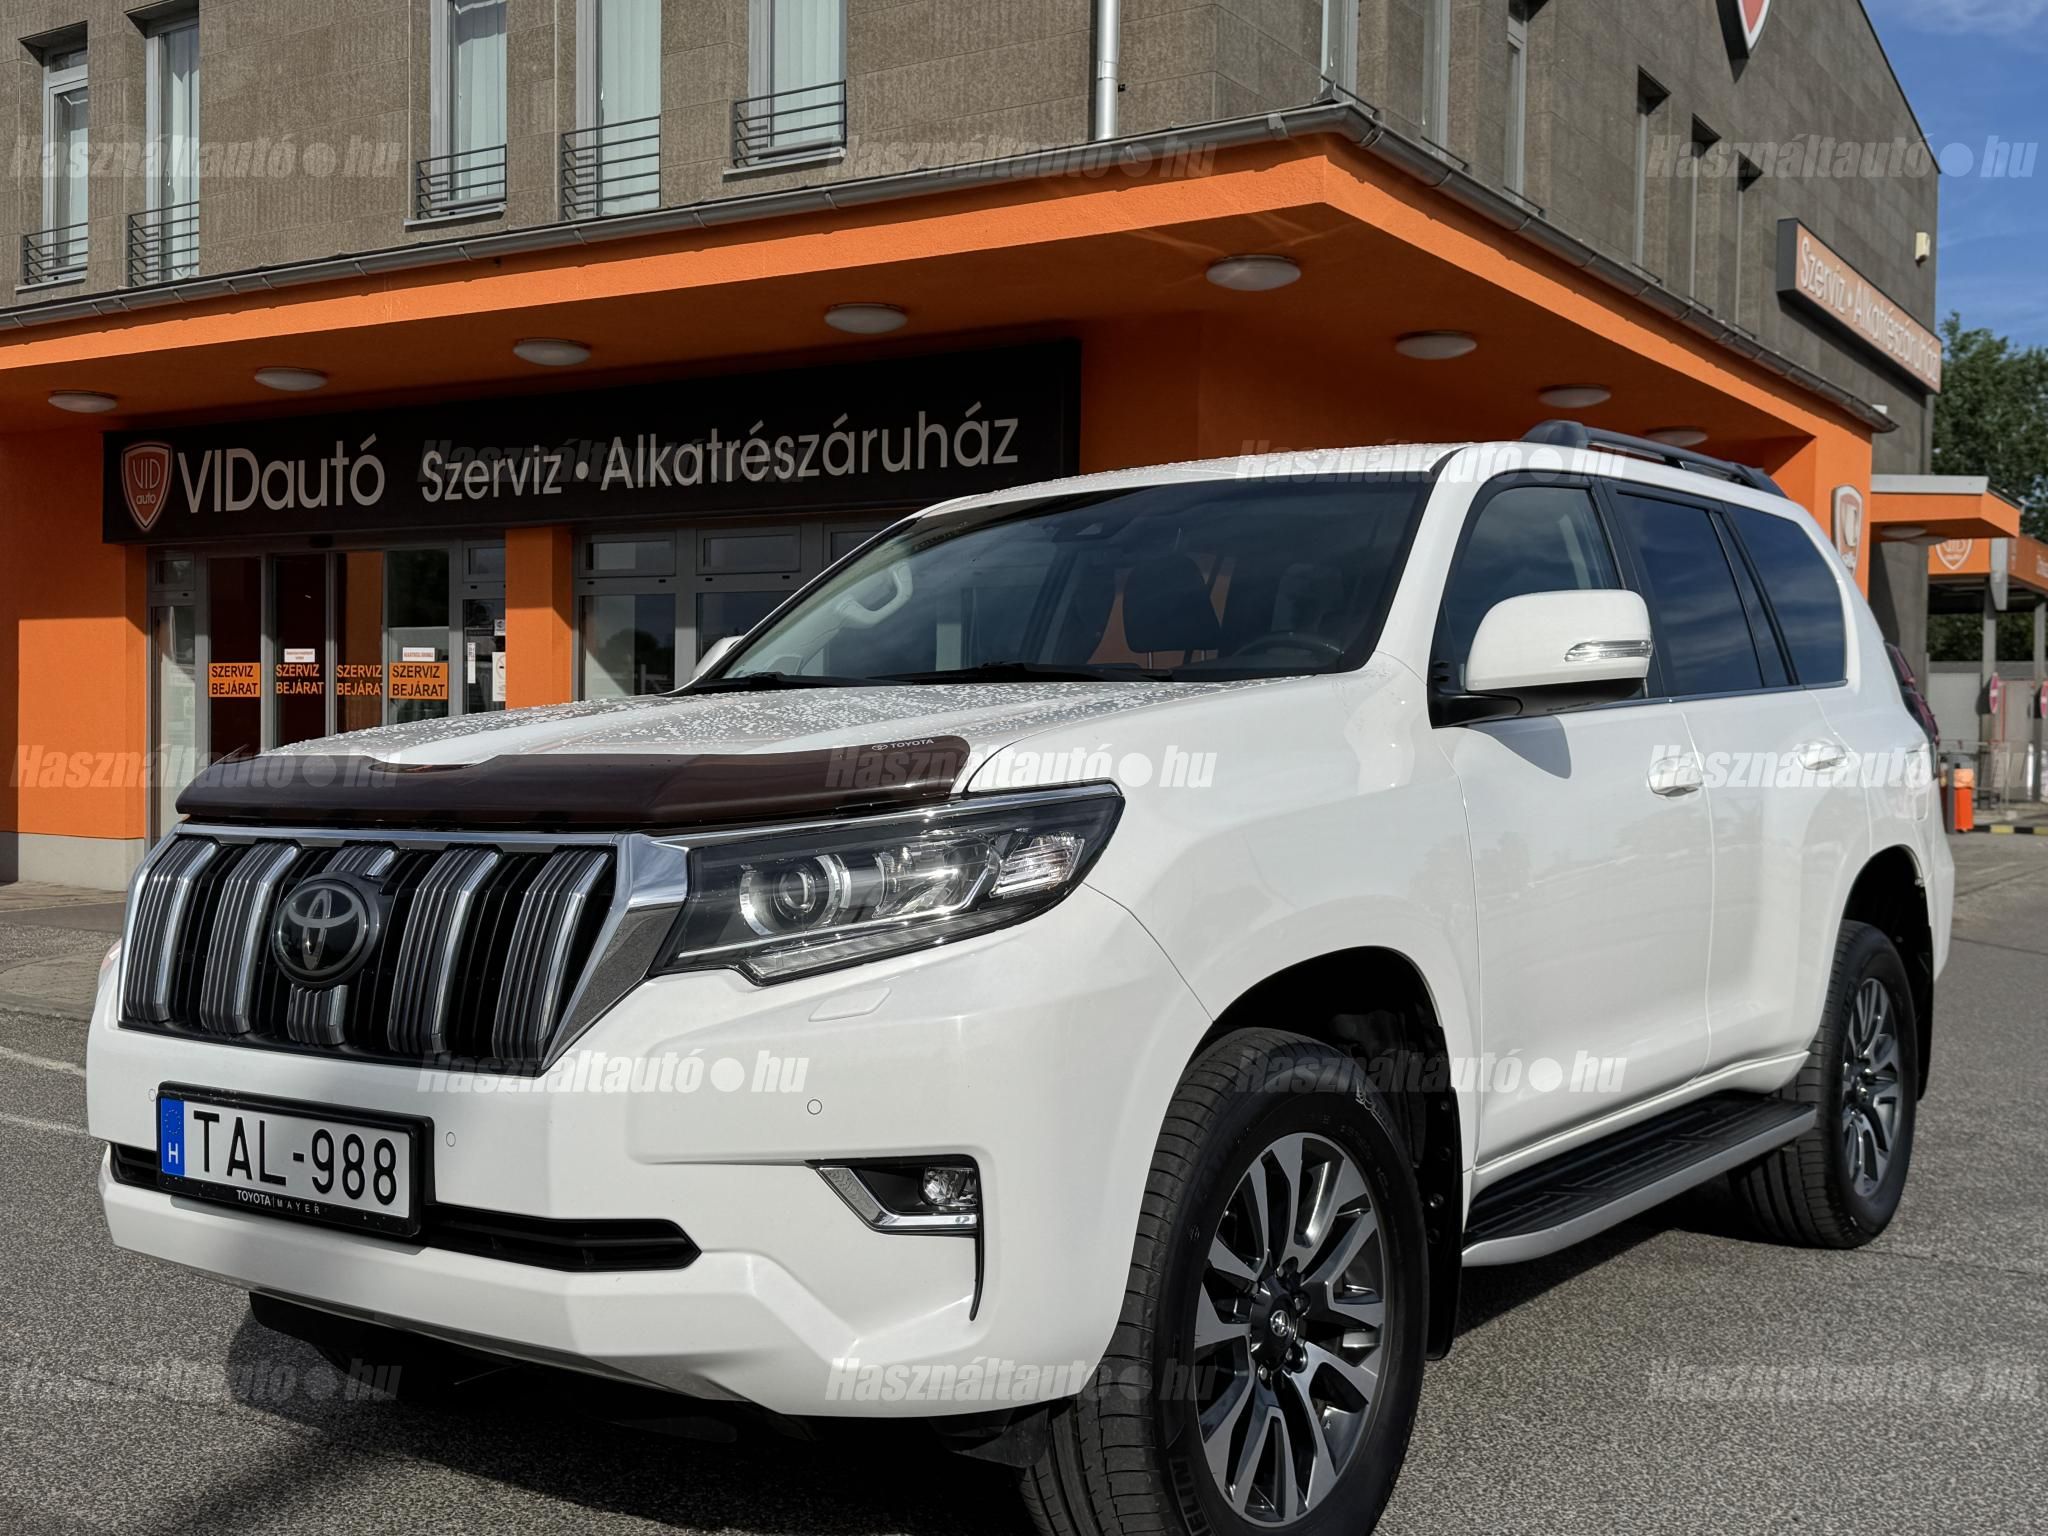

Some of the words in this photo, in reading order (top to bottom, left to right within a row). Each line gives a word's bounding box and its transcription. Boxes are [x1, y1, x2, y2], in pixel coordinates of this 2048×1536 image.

[1800, 236, 1846, 315] Szerviz
[421, 444, 562, 502] Szerviz
[600, 402, 1019, 492] Alkatrészáruház
[132, 458, 161, 489] VID
[177, 433, 386, 514] VIDautó
[211, 665, 254, 678] SZERVIZ
[275, 664, 320, 677] SZERVIZ
[336, 665, 382, 678] SZERVIZ
[392, 665, 440, 679] SZERVIZ
[211, 680, 258, 695] BEJÁRAT
[275, 679, 324, 694] BEJÁRAT
[392, 681, 445, 697] BEJÁRAT
[890, 739, 935, 749] TOYOTA
[168, 1142, 179, 1165] H
[193, 1110, 397, 1205] TAL-988
[236, 1189, 272, 1206] TOYOTA
[277, 1199, 320, 1215] MAYER
